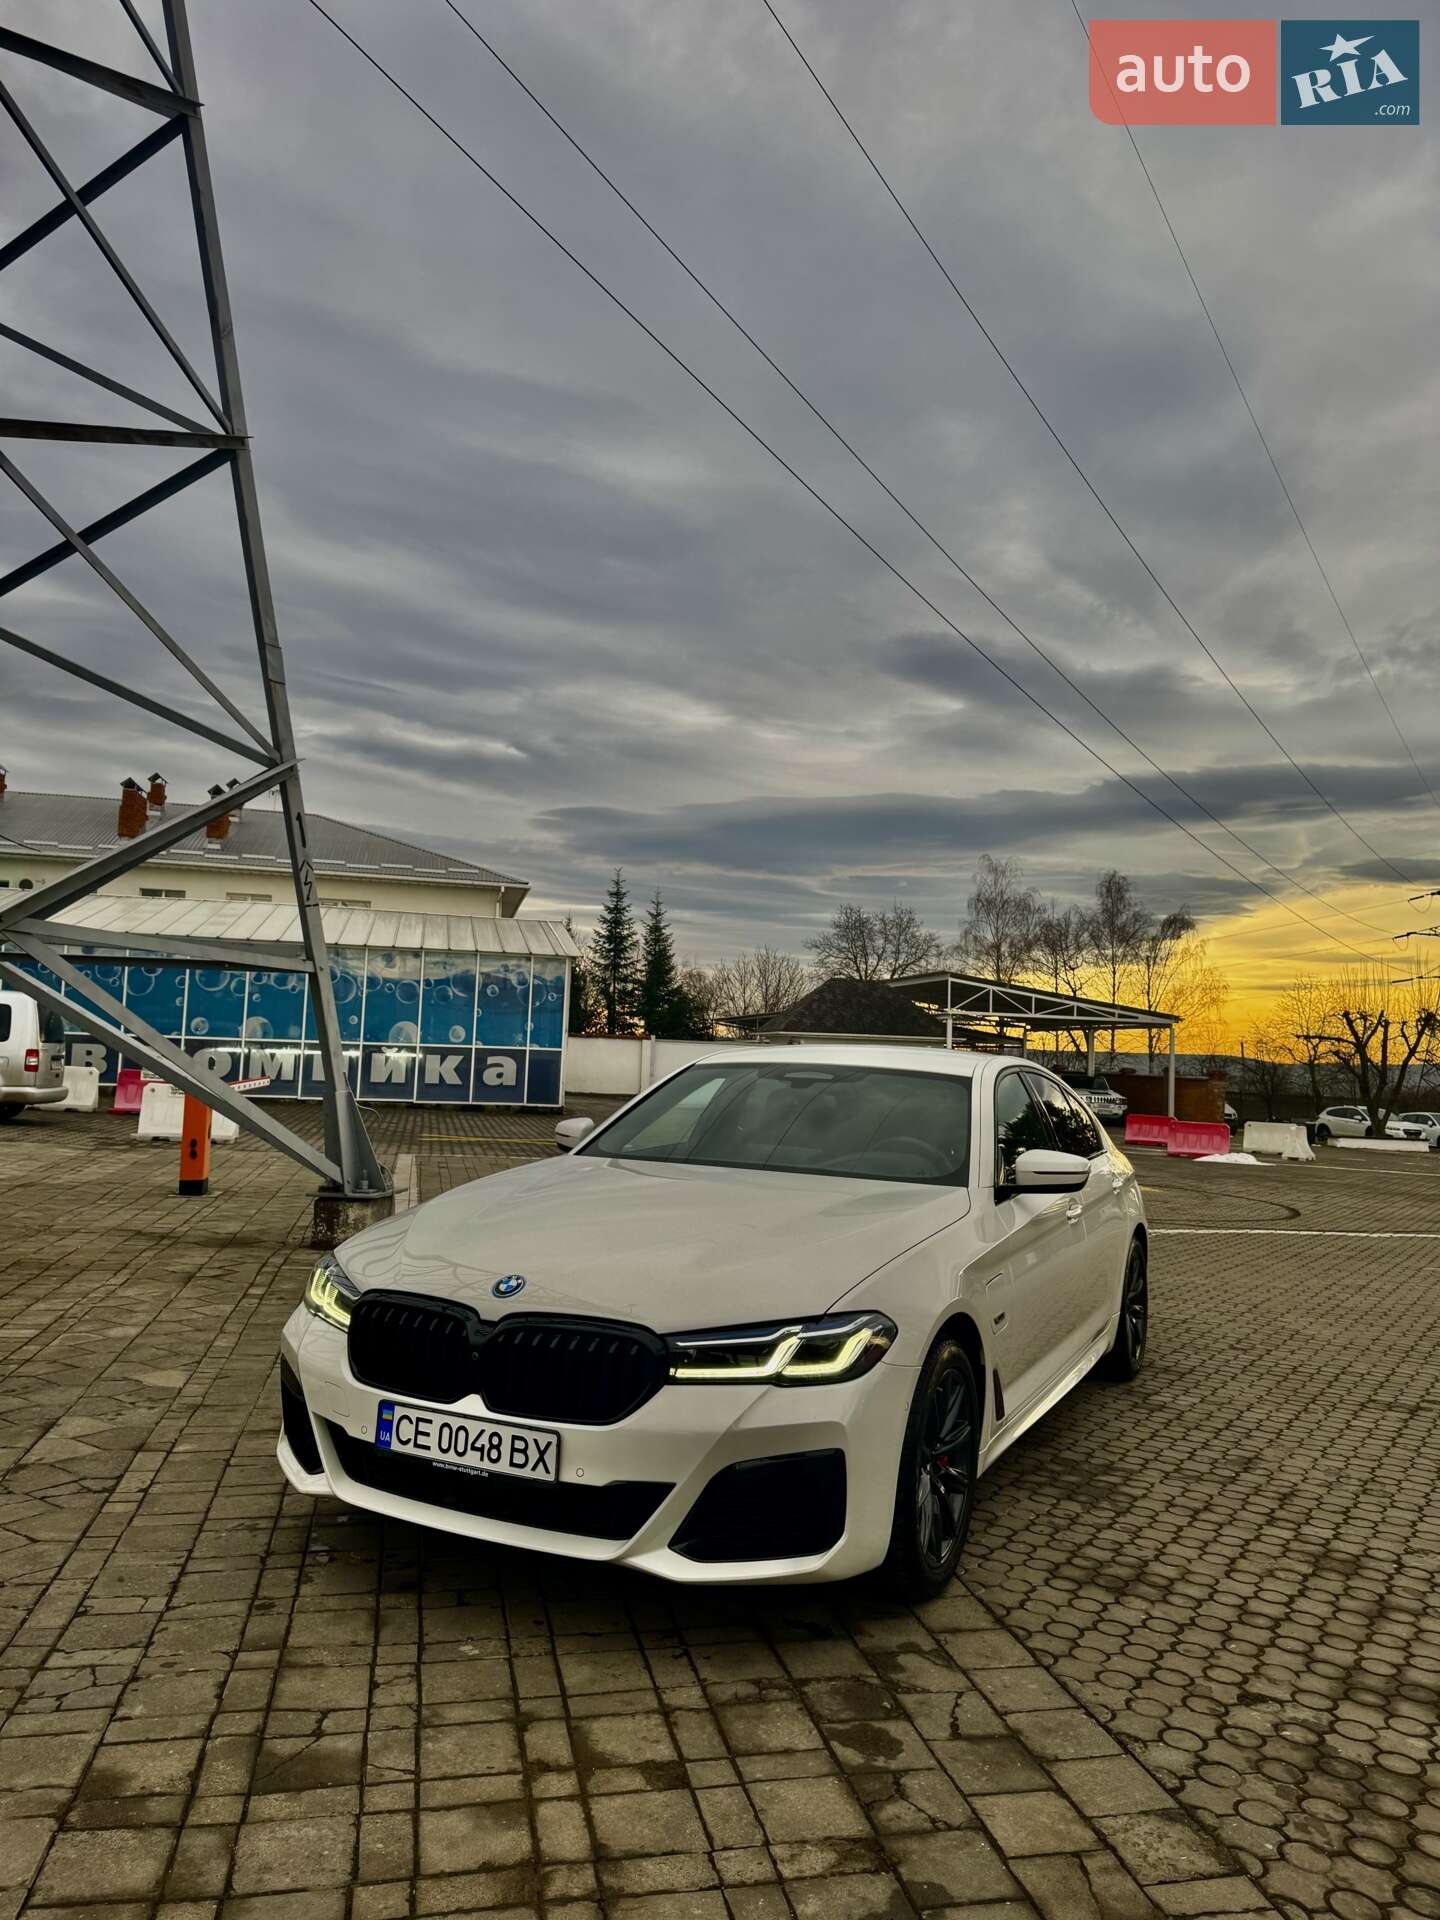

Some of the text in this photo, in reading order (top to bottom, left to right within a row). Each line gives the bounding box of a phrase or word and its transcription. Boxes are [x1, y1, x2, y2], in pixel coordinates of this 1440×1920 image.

[380, 1415, 552, 1474] UA CE 0048 BX
